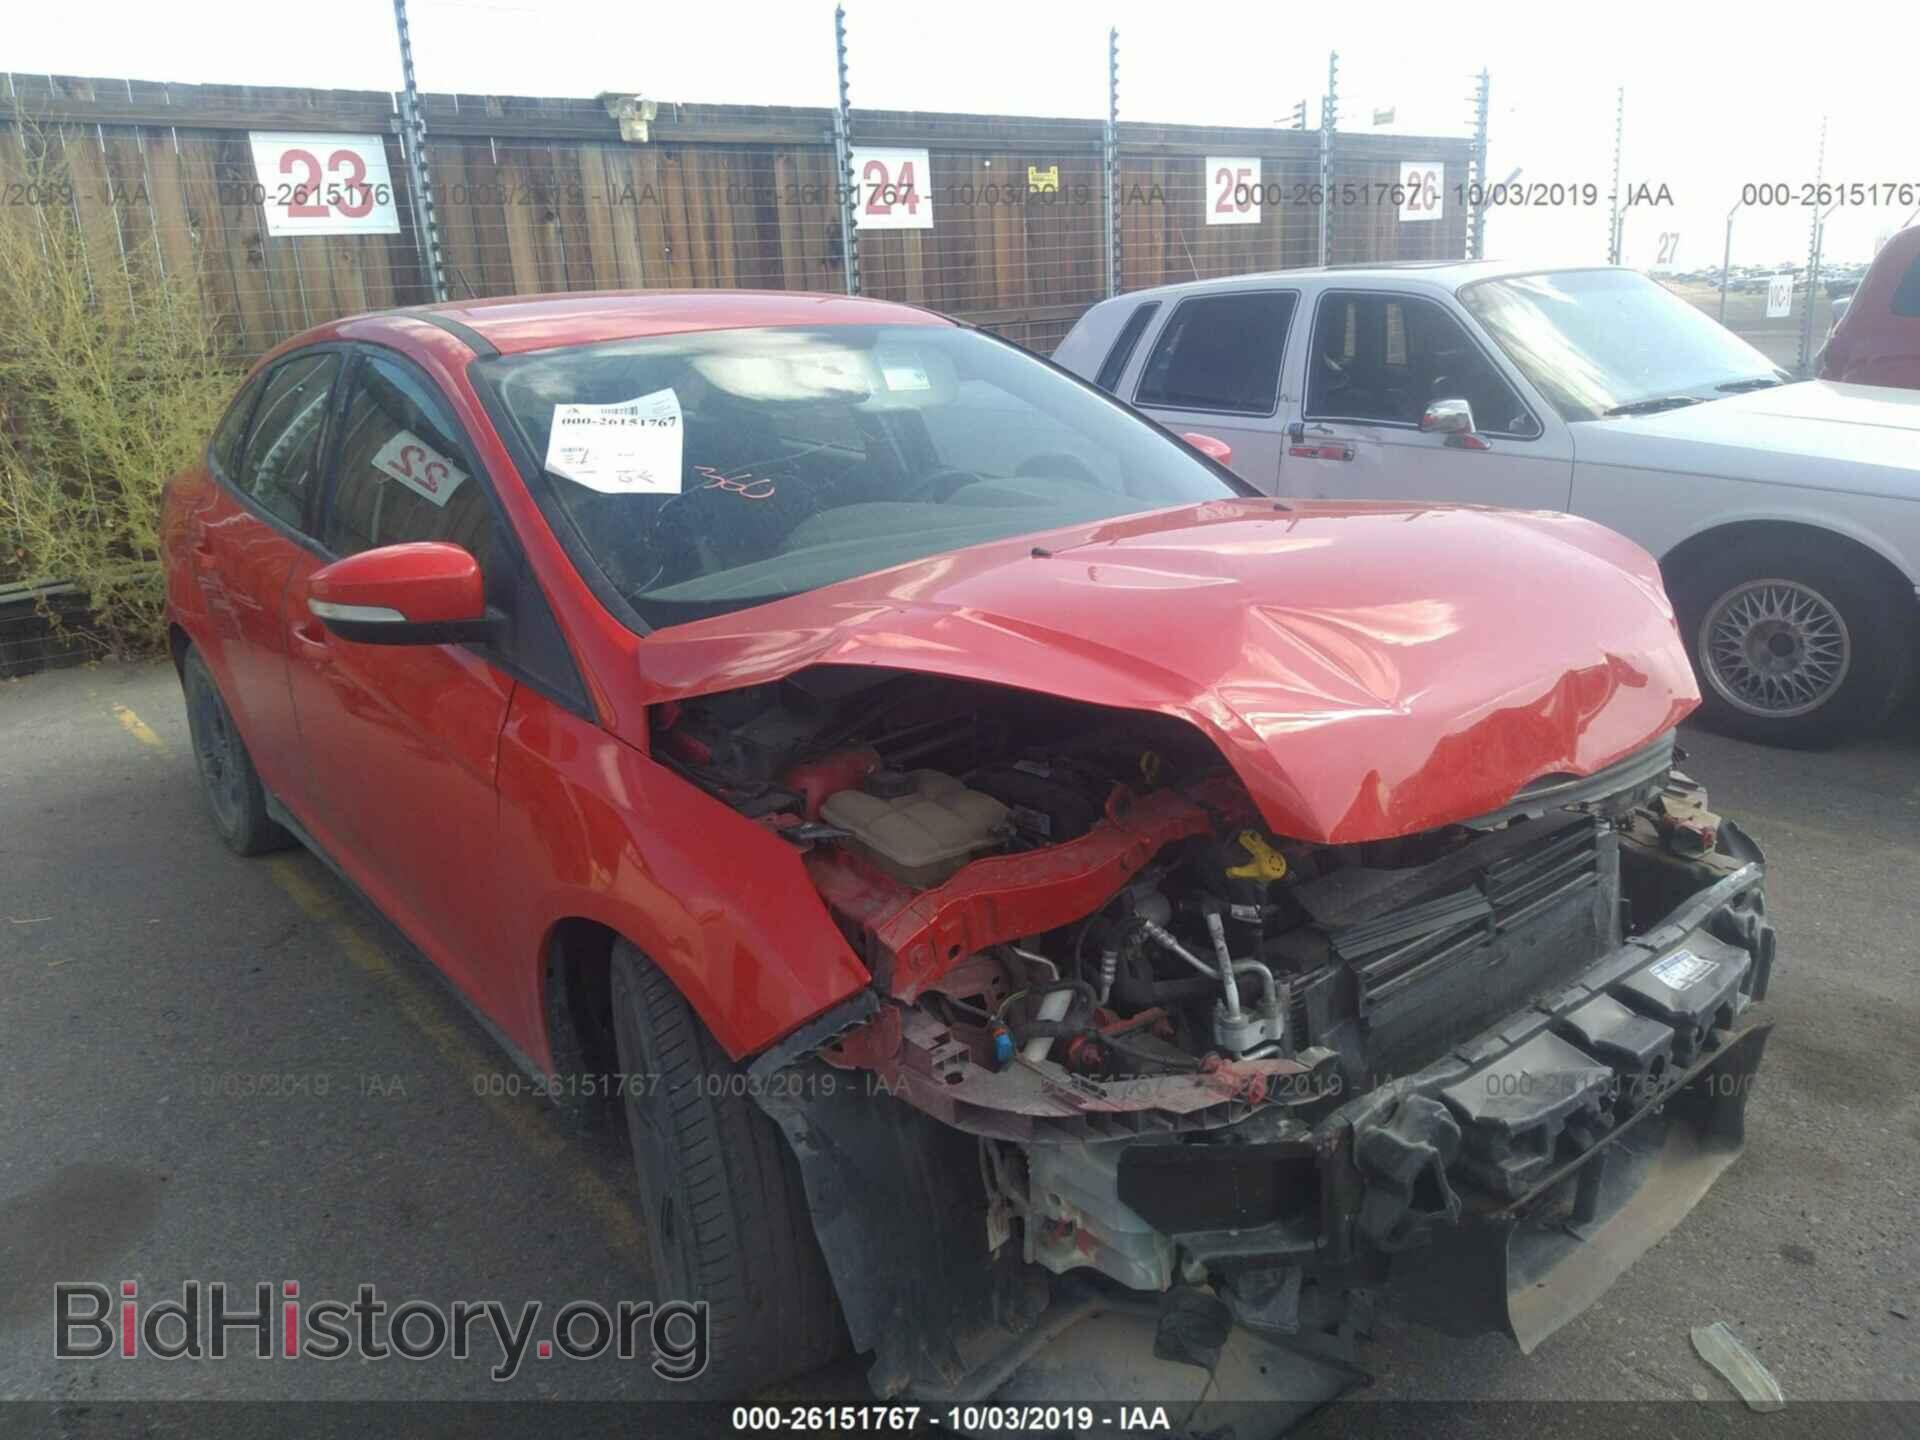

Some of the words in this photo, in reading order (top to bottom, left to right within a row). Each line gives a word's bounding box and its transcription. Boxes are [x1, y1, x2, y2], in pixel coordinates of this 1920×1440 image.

[280, 149, 374, 219] 23
[863, 159, 921, 215] 24
[1215, 167, 1253, 213] 25
[1407, 170, 1437, 211] 26
[1656, 231, 1681, 264] 27
[562, 415, 677, 428] 000-26151767
